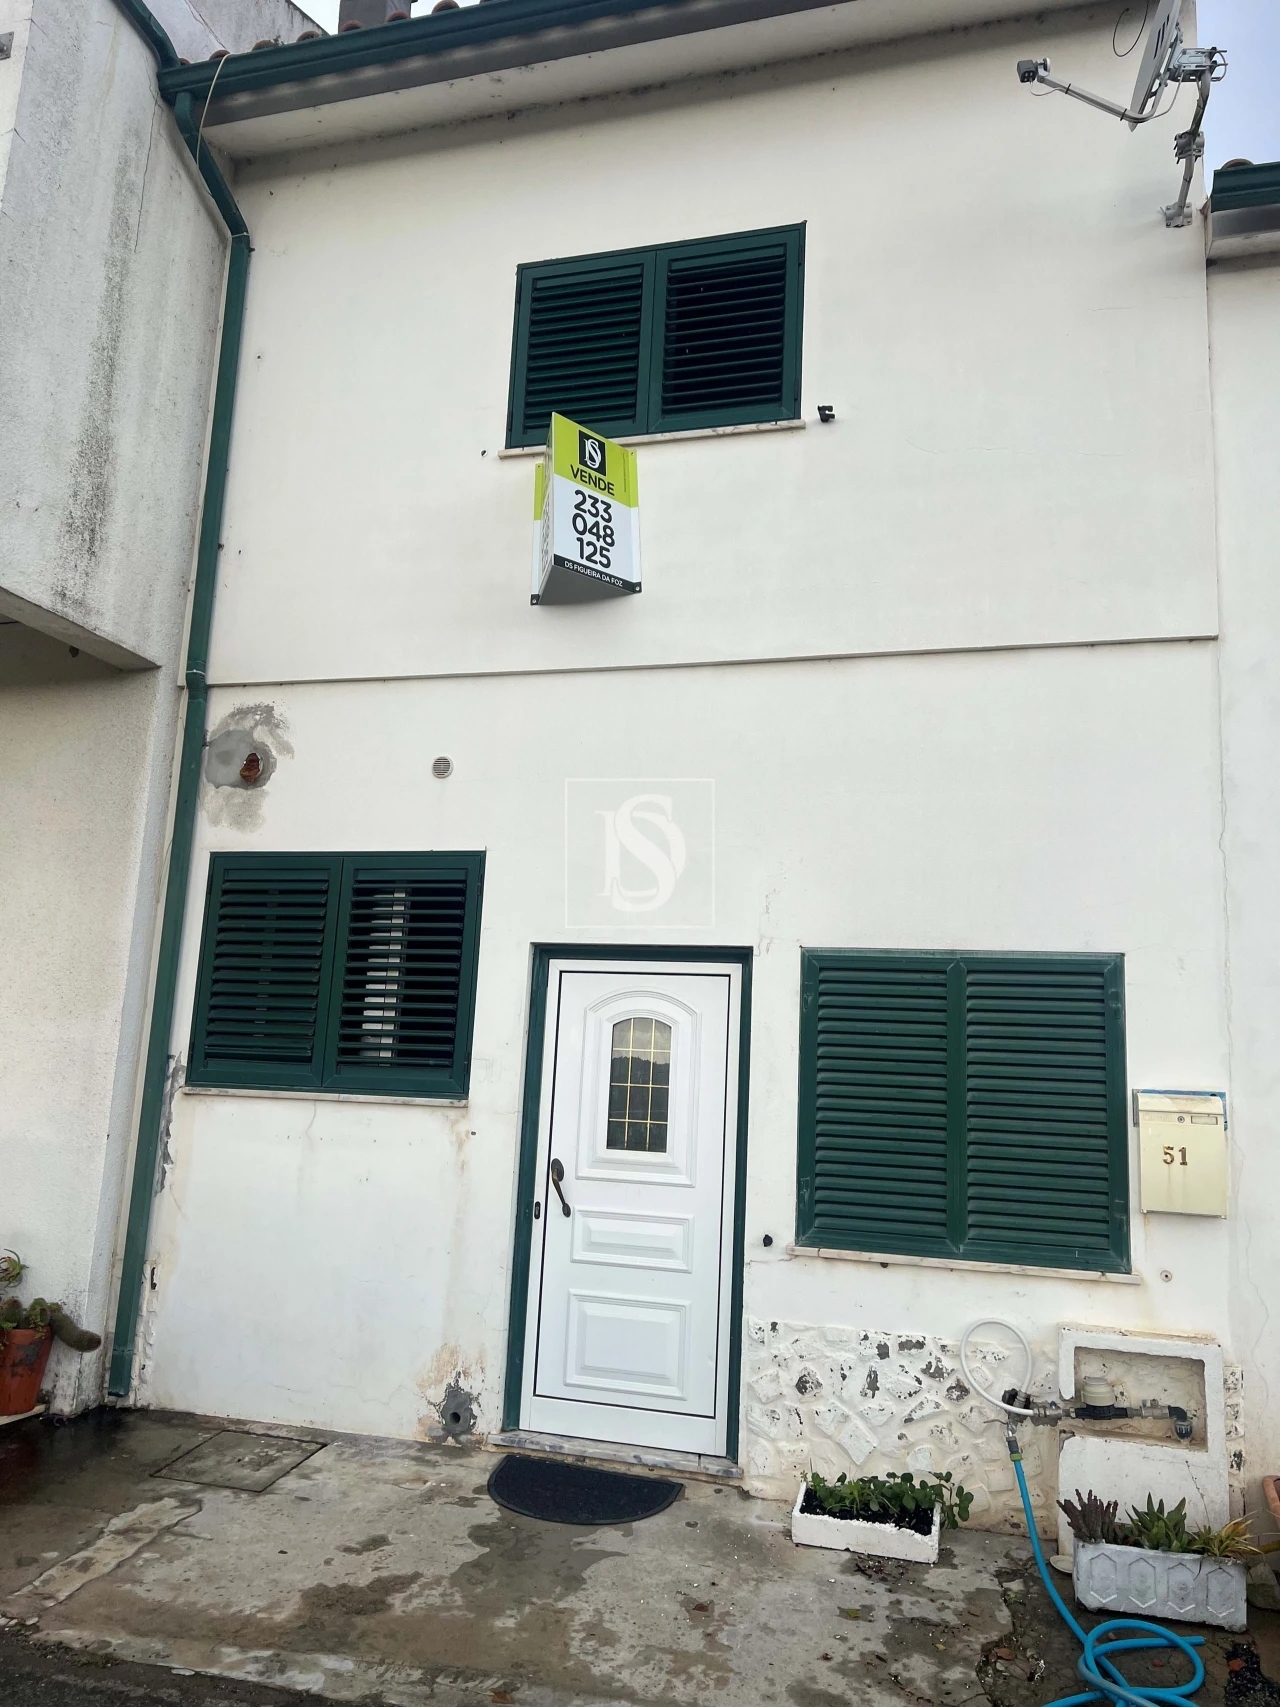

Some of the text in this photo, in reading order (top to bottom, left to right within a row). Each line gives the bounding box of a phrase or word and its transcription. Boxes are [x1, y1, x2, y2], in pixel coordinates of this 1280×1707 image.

[570, 464, 615, 497] VENDE
[574, 489, 613, 524] 233
[572, 512, 616, 547] 048
[576, 537, 612, 569] 125
[564, 560, 623, 587] DS FIGUEIRA DA FOZ
[1162, 1145, 1188, 1166] 51
